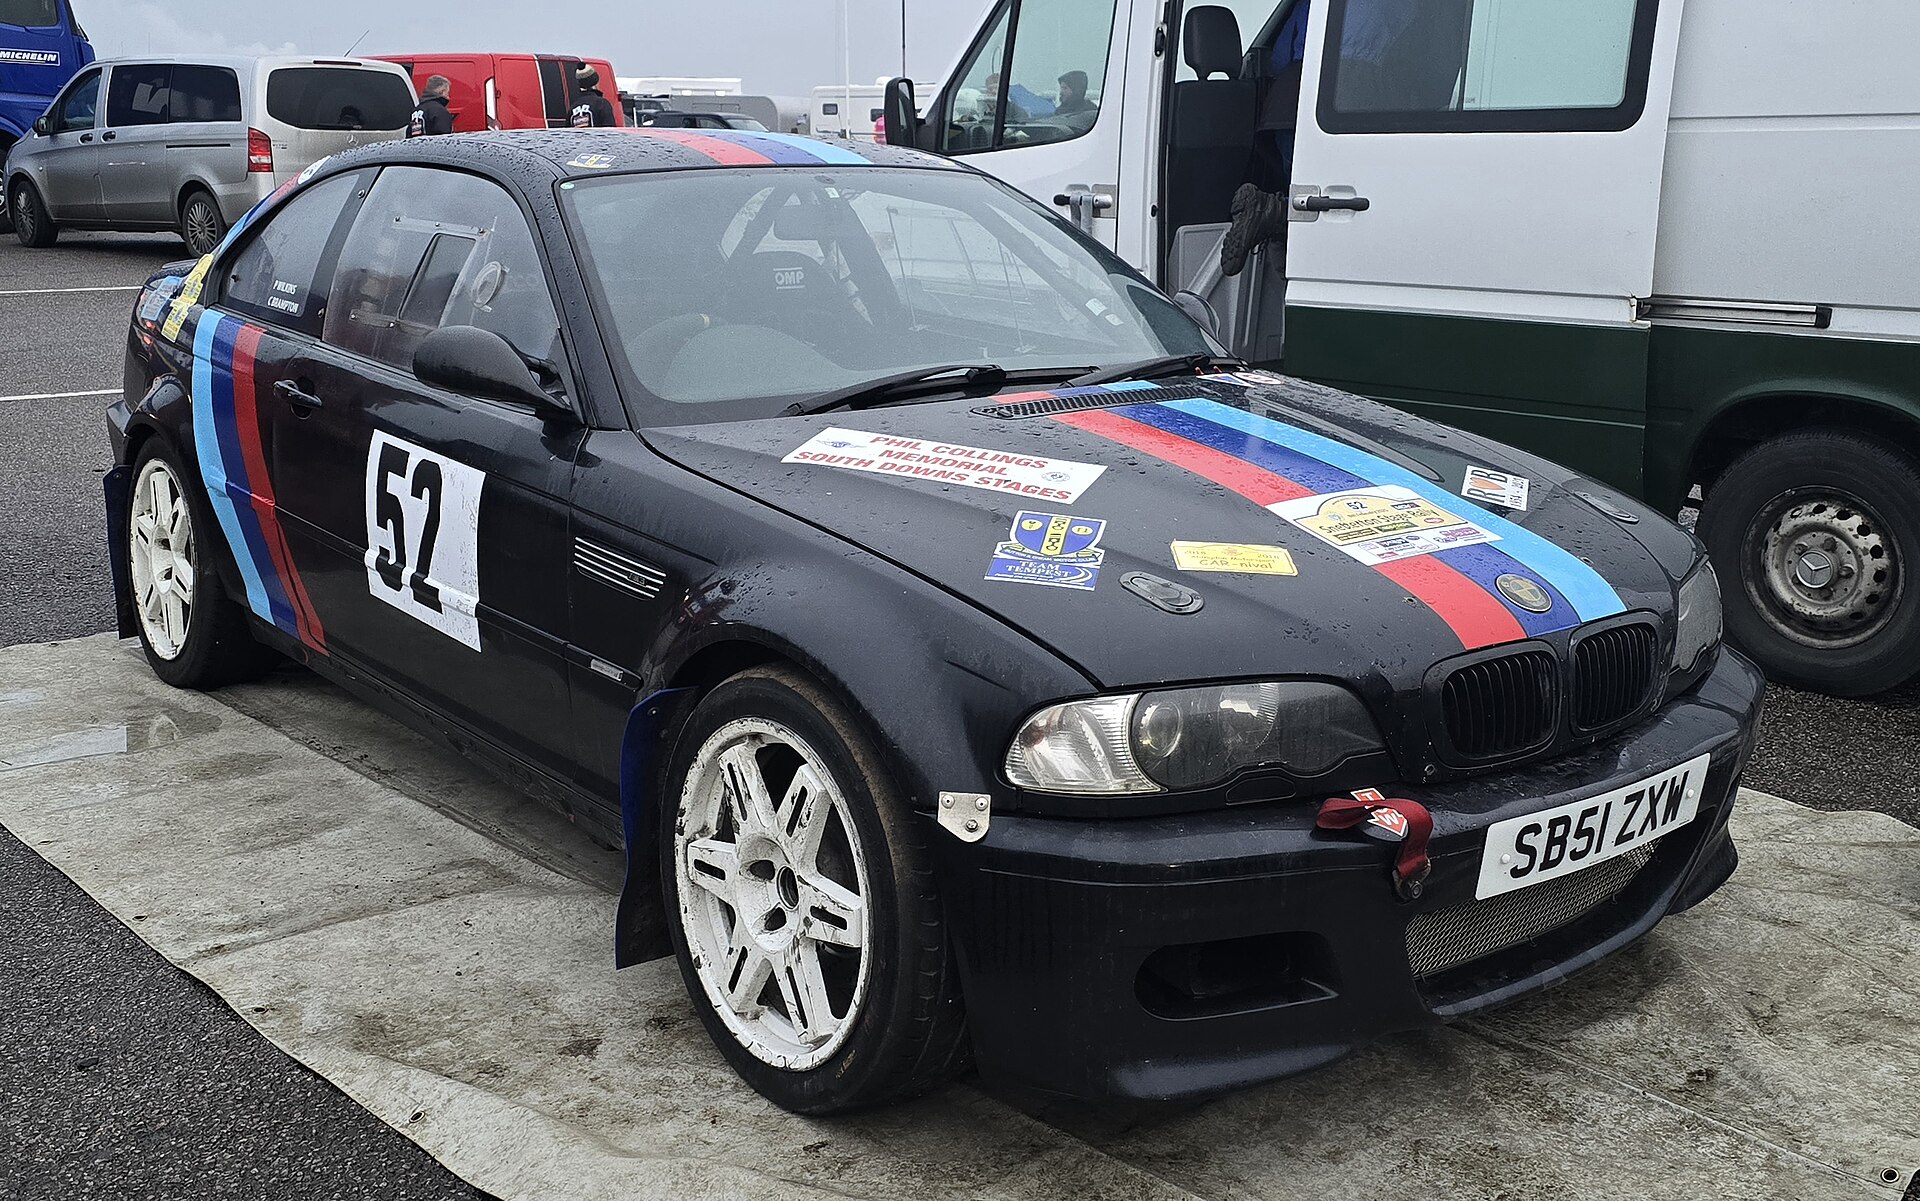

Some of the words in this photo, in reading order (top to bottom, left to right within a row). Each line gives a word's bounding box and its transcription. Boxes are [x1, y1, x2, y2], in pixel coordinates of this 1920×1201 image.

[0, 51, 57, 61] MICHELIN
[775, 271, 804, 286] OMP
[870, 436, 923, 450] PHIL
[933, 446, 1048, 469] COLLINGS
[879, 450, 1008, 475] MEMORIAL
[794, 451, 875, 467] SOUTH
[877, 462, 969, 481] DOWNS
[974, 476, 1072, 500] STAGES
[1345, 501, 1368, 510] 52
[376, 441, 443, 615] 52
[1319, 515, 1381, 534] Snetterton
[1006, 565, 1072, 577] TEMPEST
[1019, 560, 1060, 571] TEAM
[1199, 559, 1273, 569] CAR-nival
[1510, 801, 1613, 880] SB51
[1614, 770, 1690, 847] ZXW
